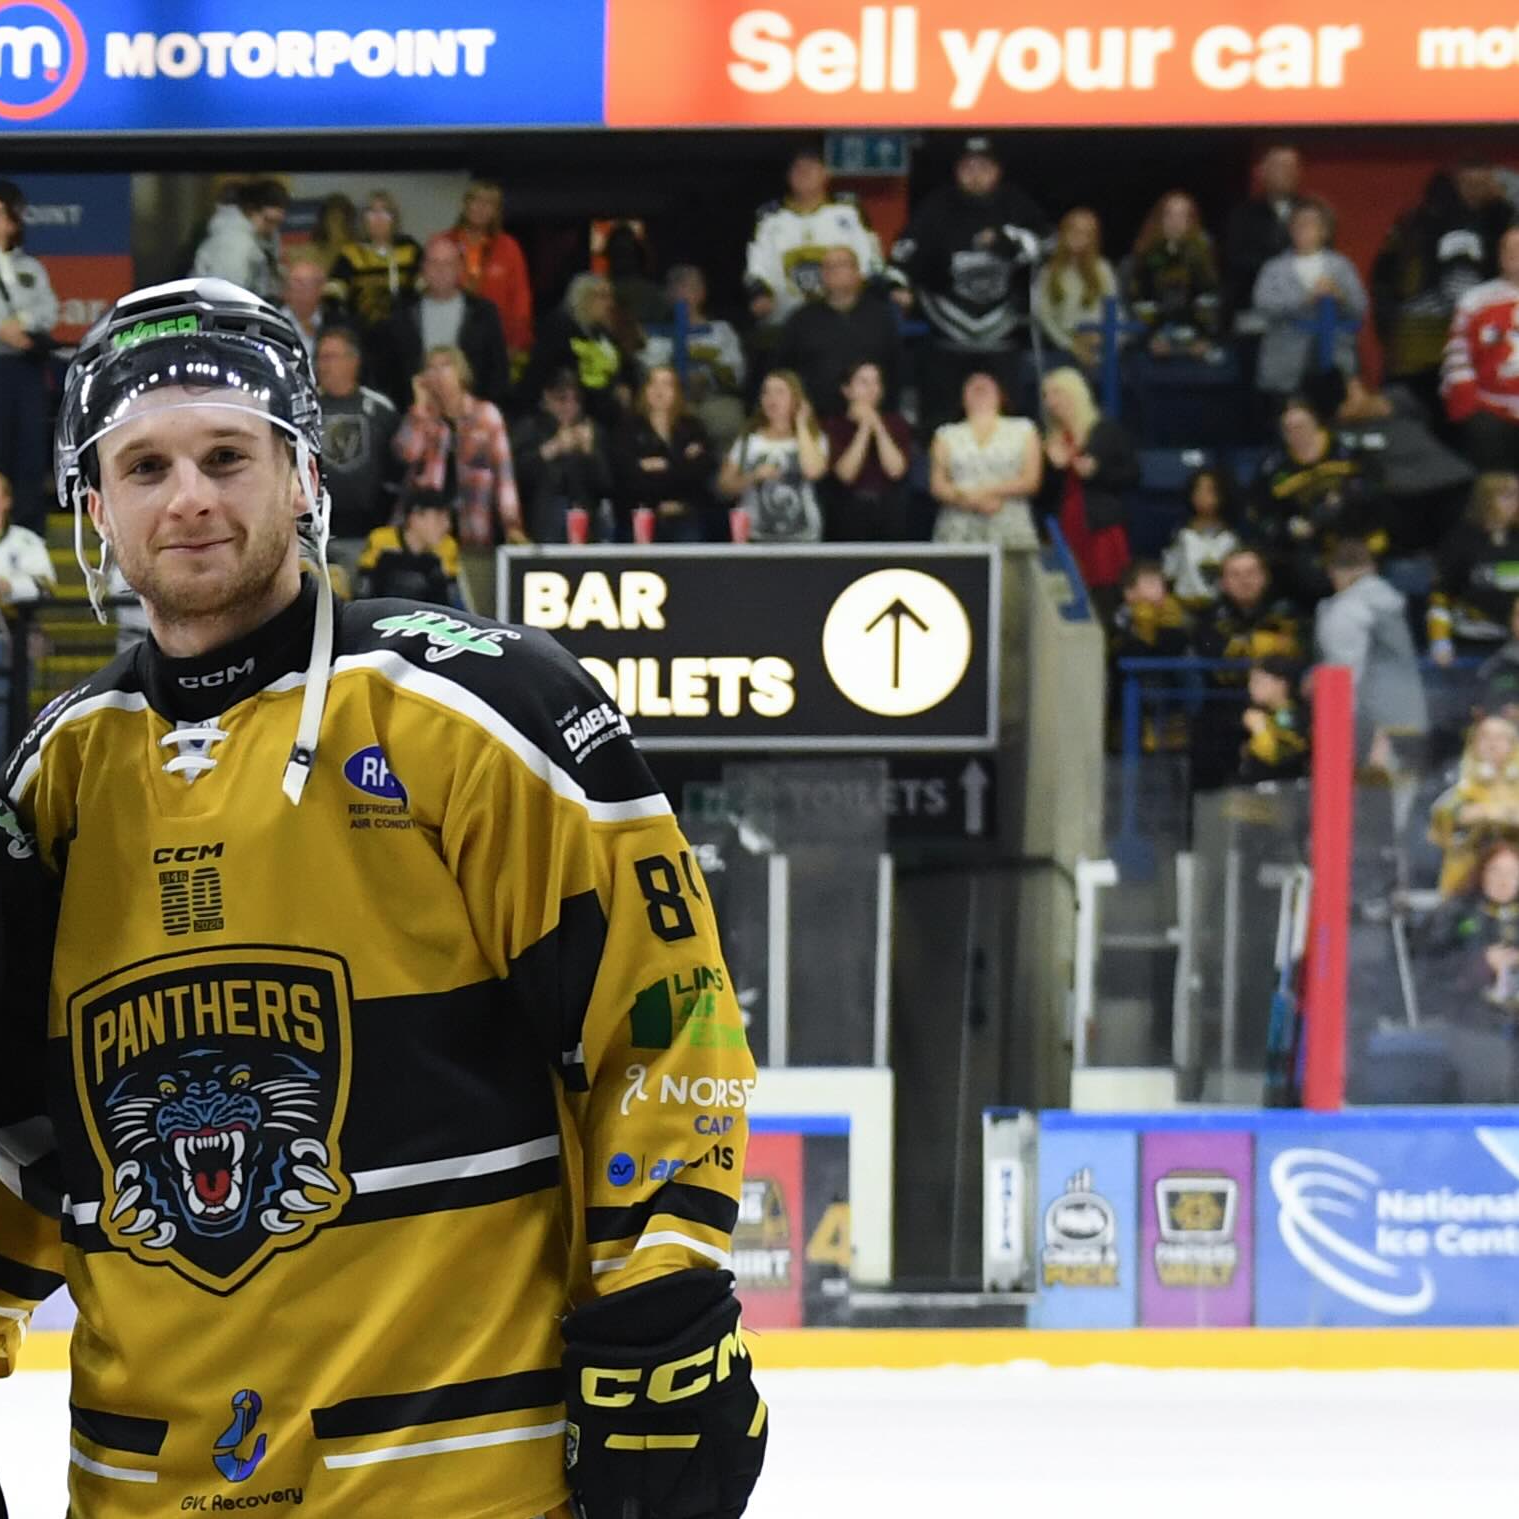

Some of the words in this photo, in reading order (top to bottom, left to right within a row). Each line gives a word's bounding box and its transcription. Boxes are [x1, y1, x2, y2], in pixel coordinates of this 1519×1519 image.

[105, 29, 496, 79] MOTORPOINT
[727, 6, 918, 93] Sell
[940, 25, 1173, 109] your
[1191, 23, 1361, 90] car
[523, 570, 668, 630] BAR
[178, 657, 255, 689] CCM
[152, 841, 225, 865] CCM
[92, 979, 326, 1087] PANTHERS
[580, 1315, 747, 1408] CCM
[211, 1486, 304, 1512] Recovery
